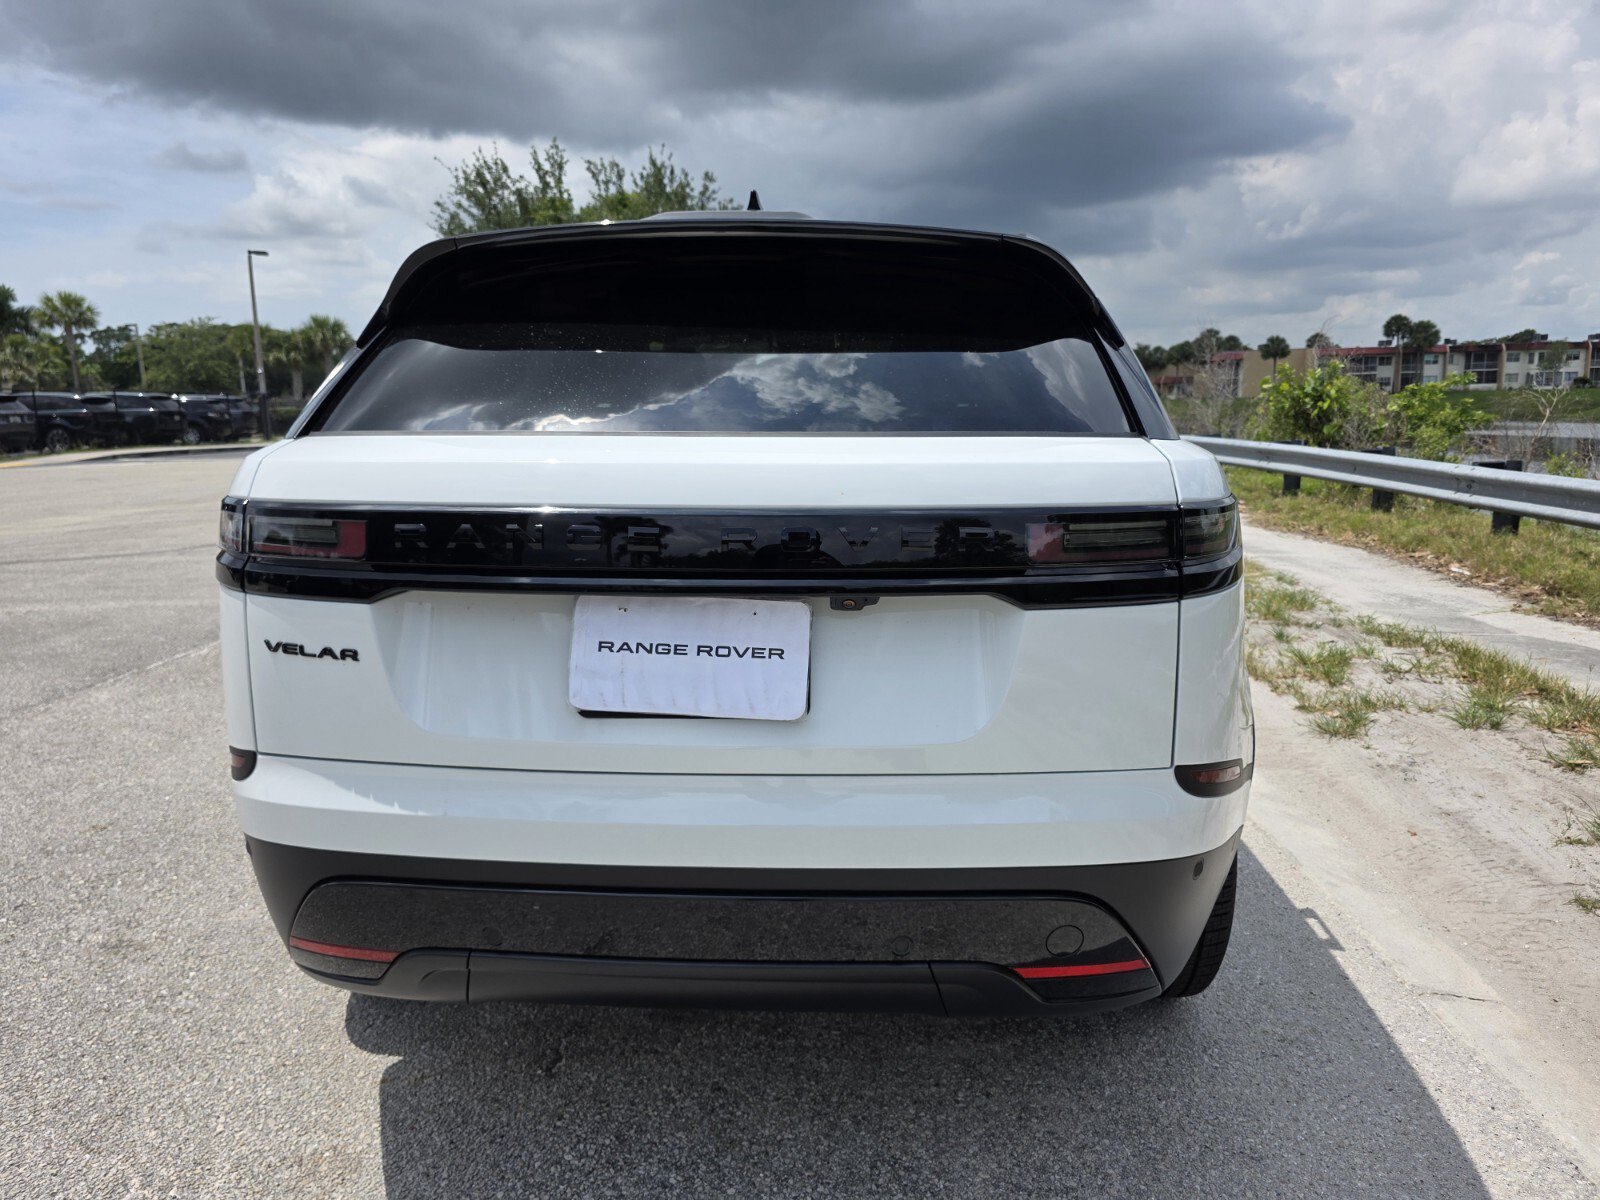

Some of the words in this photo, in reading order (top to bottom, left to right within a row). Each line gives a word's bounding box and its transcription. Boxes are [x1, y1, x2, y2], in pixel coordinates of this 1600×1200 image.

[393, 523, 660, 552] RANGE
[721, 526, 996, 553] ROVER
[264, 639, 360, 661] VELAR
[598, 641, 689, 656] RANGE
[697, 644, 786, 660] ROVER
